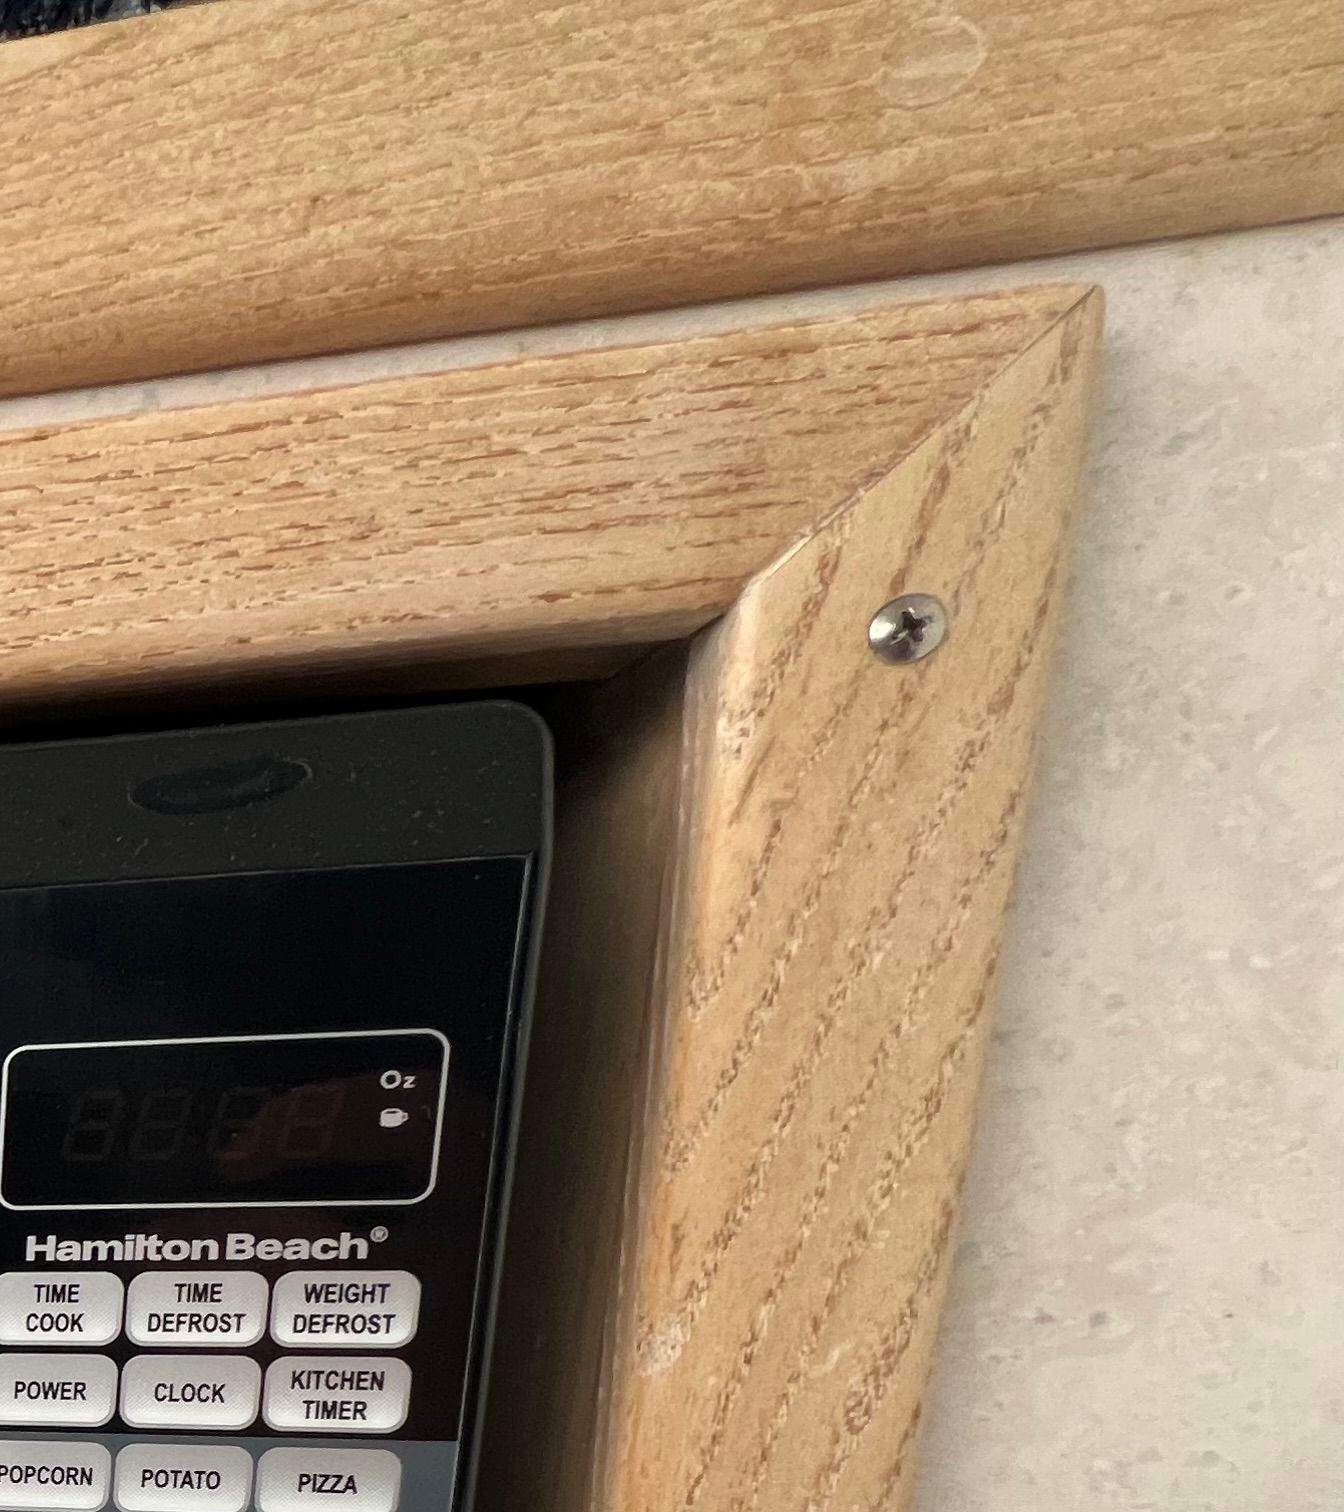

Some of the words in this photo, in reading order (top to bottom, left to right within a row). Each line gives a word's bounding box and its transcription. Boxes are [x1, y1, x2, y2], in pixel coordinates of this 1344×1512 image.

[379, 1069, 416, 1090] Oz
[25, 1233, 219, 1262] Hamilton
[33, 1283, 81, 1304] TIME
[174, 1282, 223, 1303] TIME
[303, 1283, 391, 1304] WEIGHT
[25, 1312, 85, 1333] COOK
[147, 1312, 247, 1333] DEFROST
[292, 1313, 397, 1335] DEFROST
[14, 1380, 87, 1401] POWER
[290, 1369, 386, 1391] KITCHEN
[154, 1382, 226, 1404] CLOCK
[302, 1399, 368, 1421] TIMER
[140, 1468, 221, 1490] POTATO
[297, 1473, 358, 1495] PIZZA
